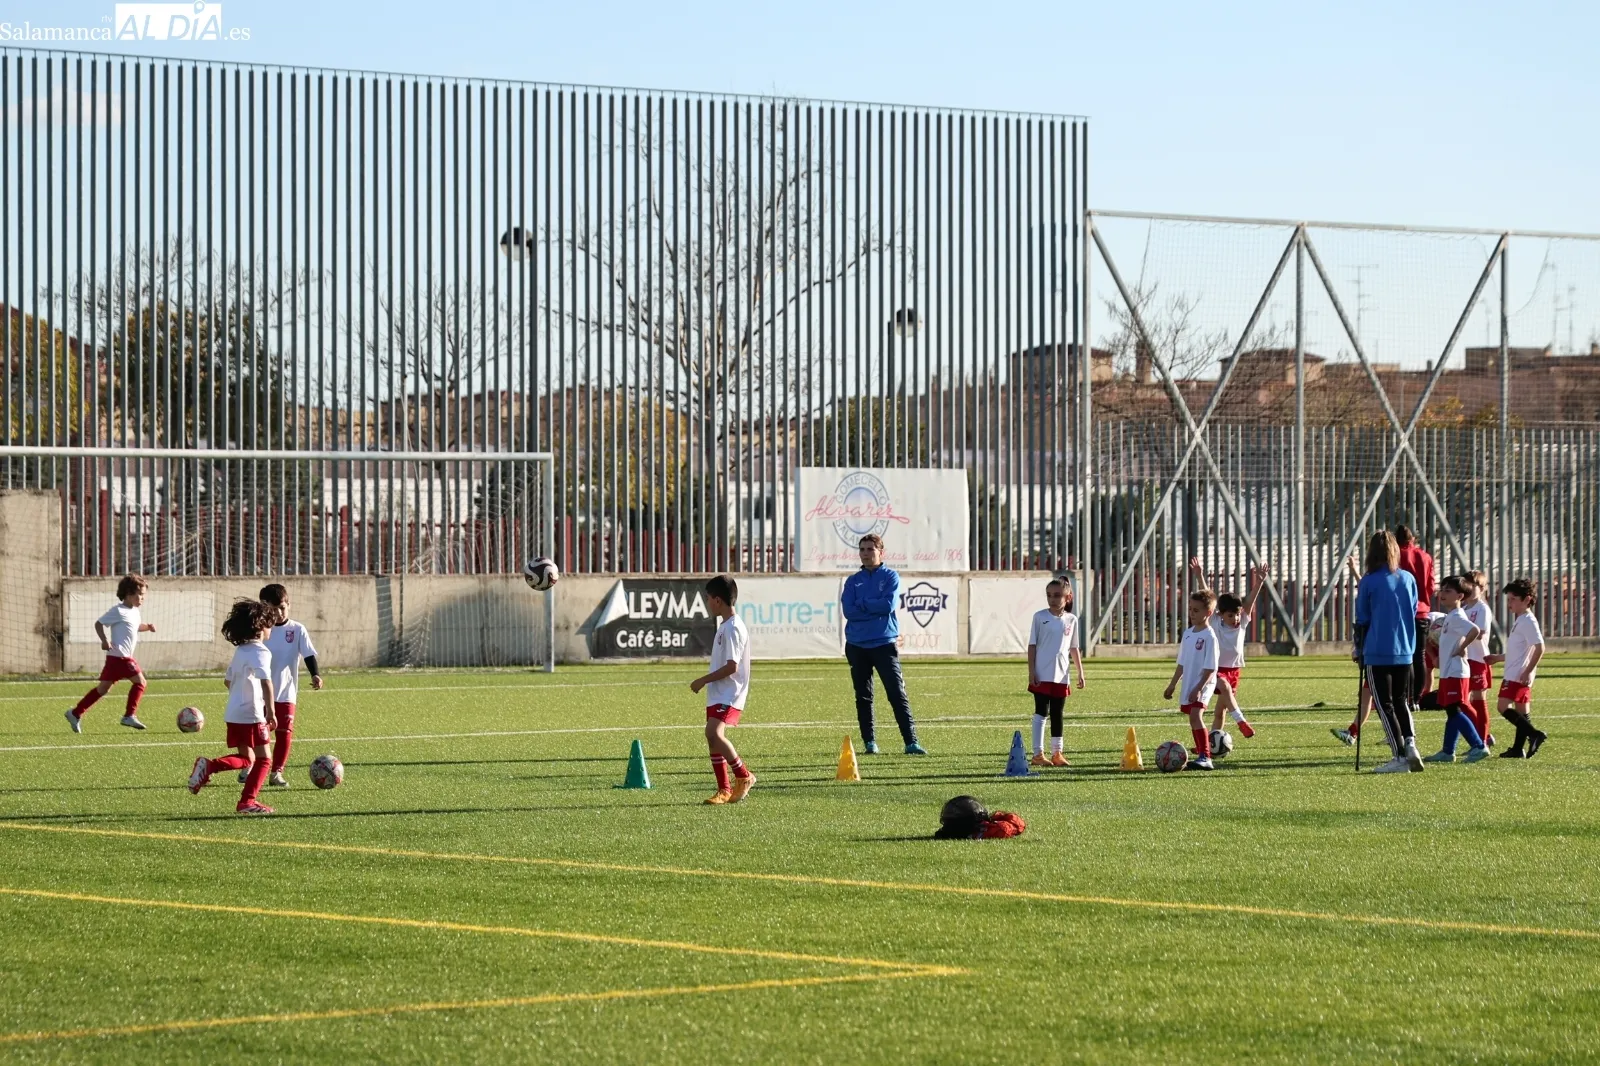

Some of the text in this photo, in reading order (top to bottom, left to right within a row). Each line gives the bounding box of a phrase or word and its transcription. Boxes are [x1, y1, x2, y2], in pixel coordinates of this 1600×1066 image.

[835, 474, 889, 506] GOMECELLO
[913, 548, 940, 561] desde
[944, 548, 963, 561] 1906
[628, 590, 709, 619] LEYMA
[906, 595, 941, 610] carpe
[616, 629, 689, 649] Café-Bar
